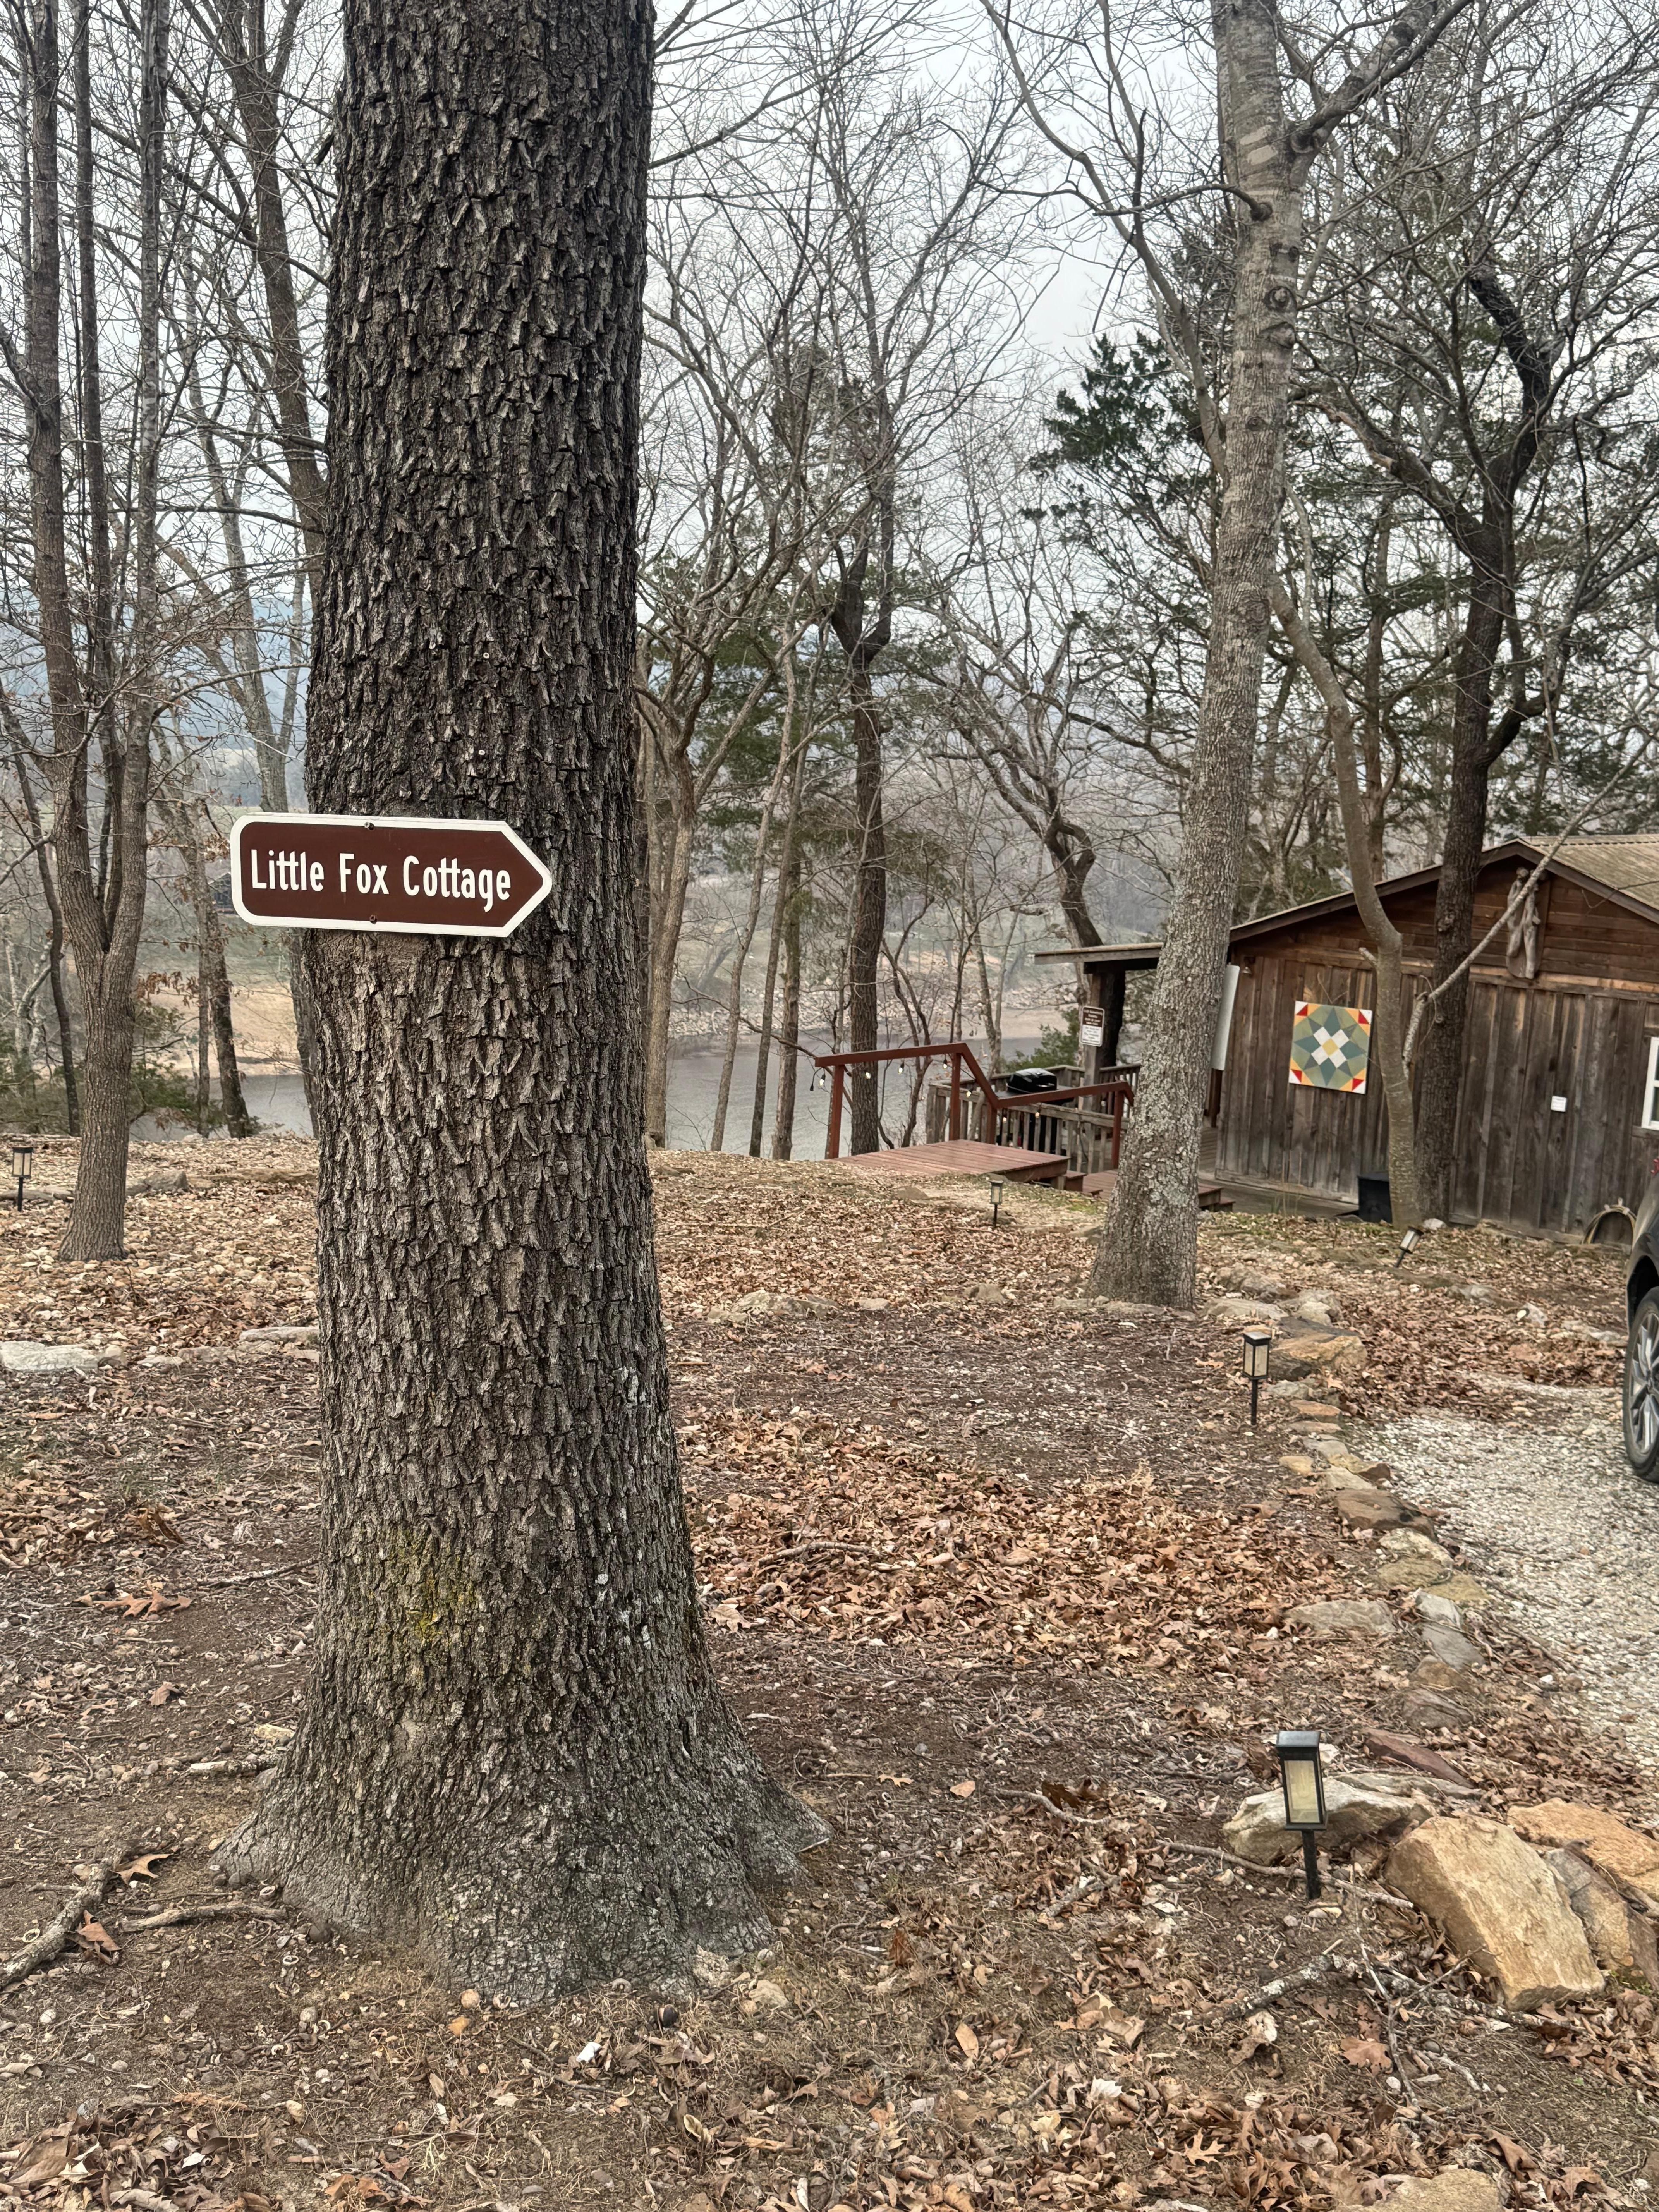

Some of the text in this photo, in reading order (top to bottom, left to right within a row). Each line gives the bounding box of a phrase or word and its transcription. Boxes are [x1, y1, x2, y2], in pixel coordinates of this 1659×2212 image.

[251, 849, 511, 912] Little Fox Cottage
